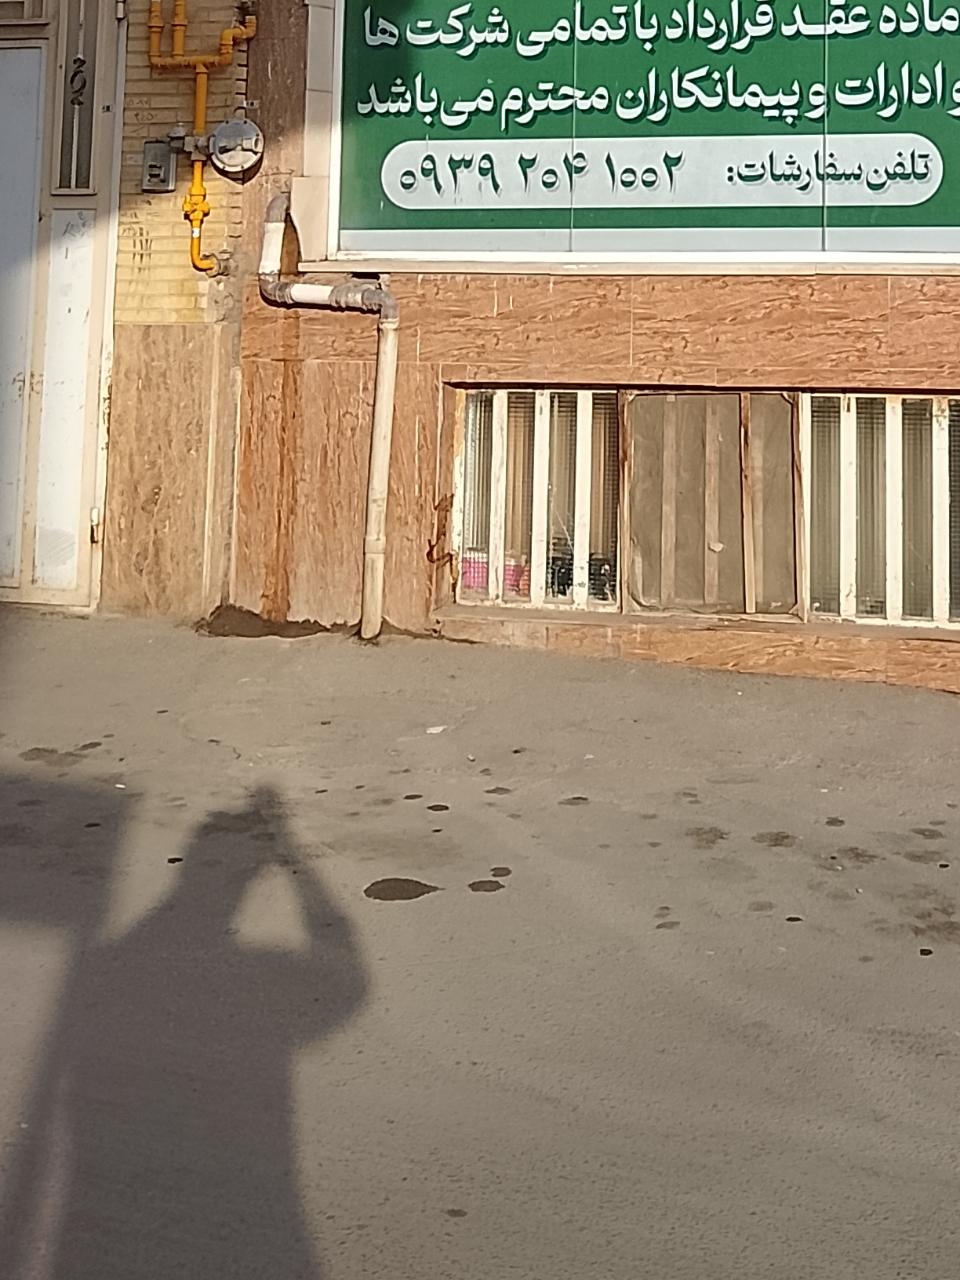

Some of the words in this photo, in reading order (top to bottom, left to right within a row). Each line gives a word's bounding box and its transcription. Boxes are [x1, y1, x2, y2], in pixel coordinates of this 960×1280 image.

[363, 5, 400, 46] ها
[405, 2, 509, 57] شرکت
[516, 0, 628, 56] تمامی
[500, 82, 609, 131] محترم
[615, 64, 801, 124] پیمانکاران
[803, 82, 828, 119] و
[834, 60, 943, 118] ادارات
[726, 150, 863, 191] سفارشات:
[866, 148, 931, 191] تلفن
